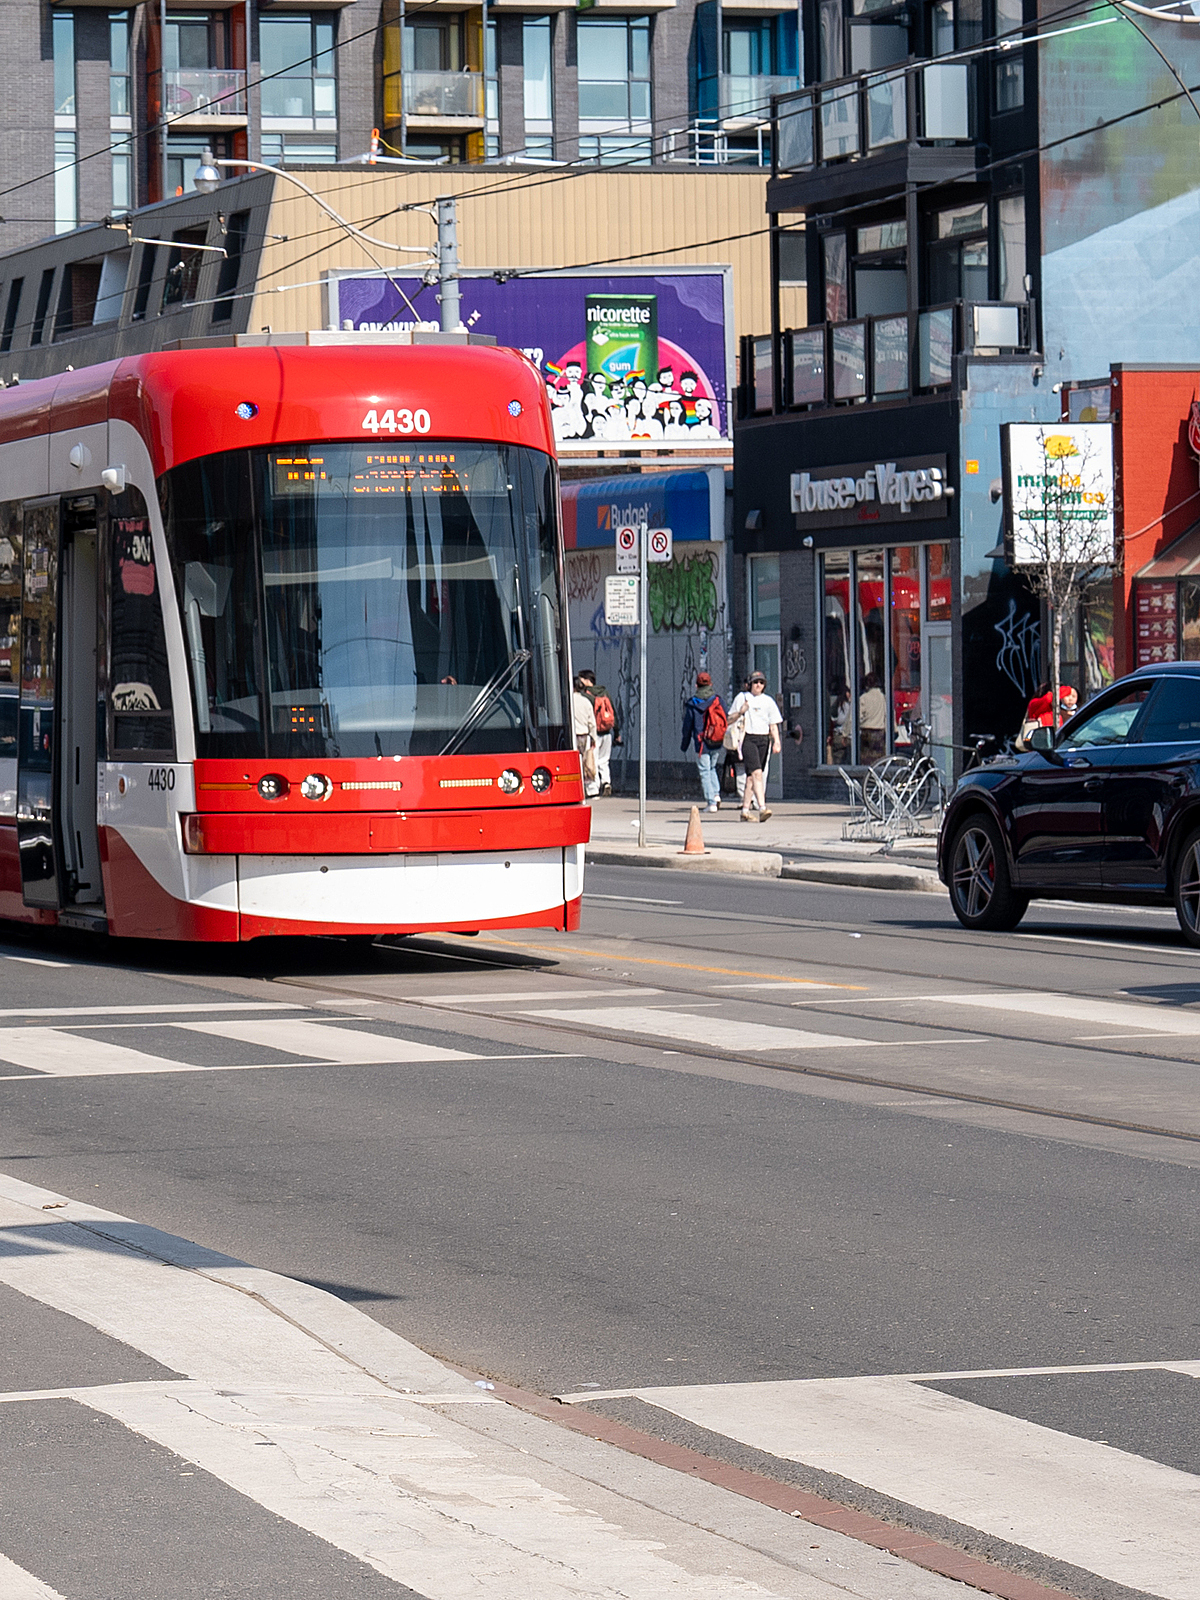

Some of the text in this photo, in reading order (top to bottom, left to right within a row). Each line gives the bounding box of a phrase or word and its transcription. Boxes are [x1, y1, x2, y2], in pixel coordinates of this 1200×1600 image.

[587, 305, 651, 324] nicorette
[609, 361, 631, 372] gum
[362, 408, 431, 434] 4430
[790, 462, 943, 514] House of Vapes
[611, 502, 649, 530] Budget
[147, 768, 175, 791] 4430
